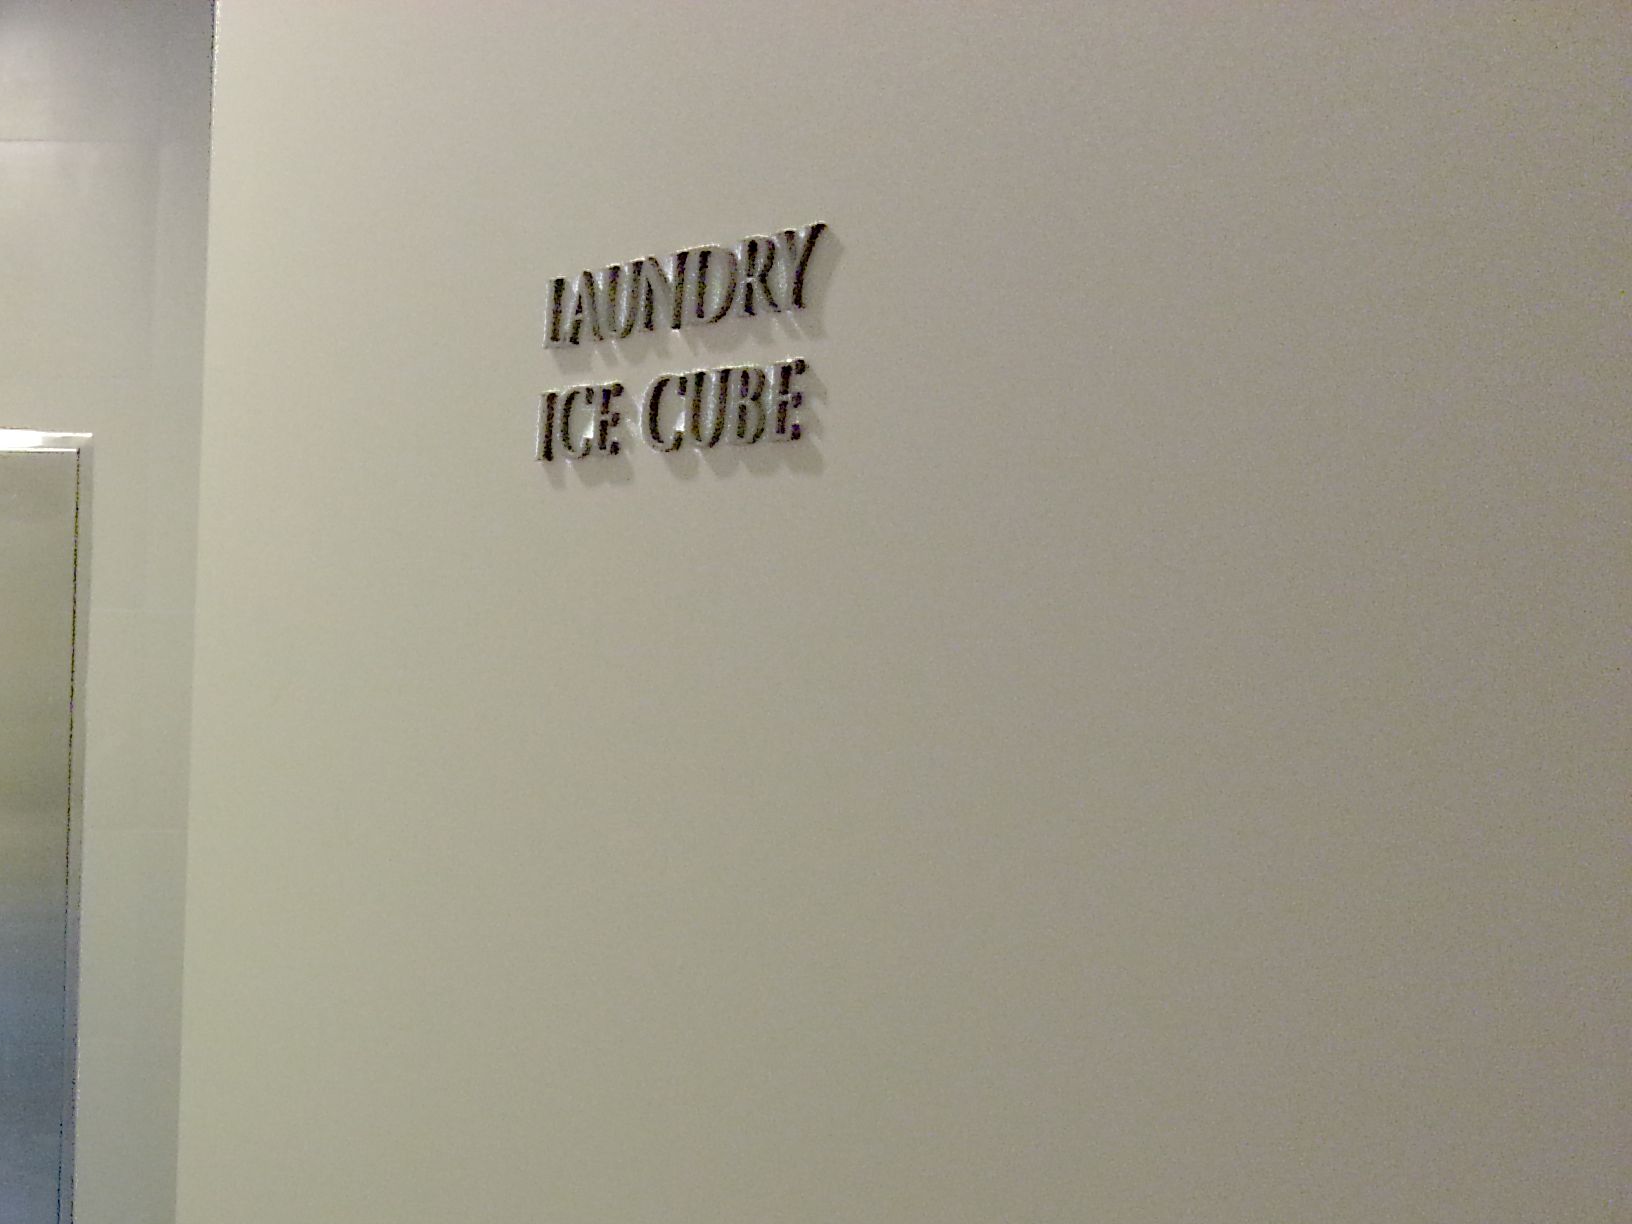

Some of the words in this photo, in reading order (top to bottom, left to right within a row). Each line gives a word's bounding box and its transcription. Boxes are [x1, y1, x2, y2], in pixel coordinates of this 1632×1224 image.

[542, 221, 828, 349] LAUNDRY
[535, 379, 625, 462] ICE
[640, 356, 808, 453] CUBE
